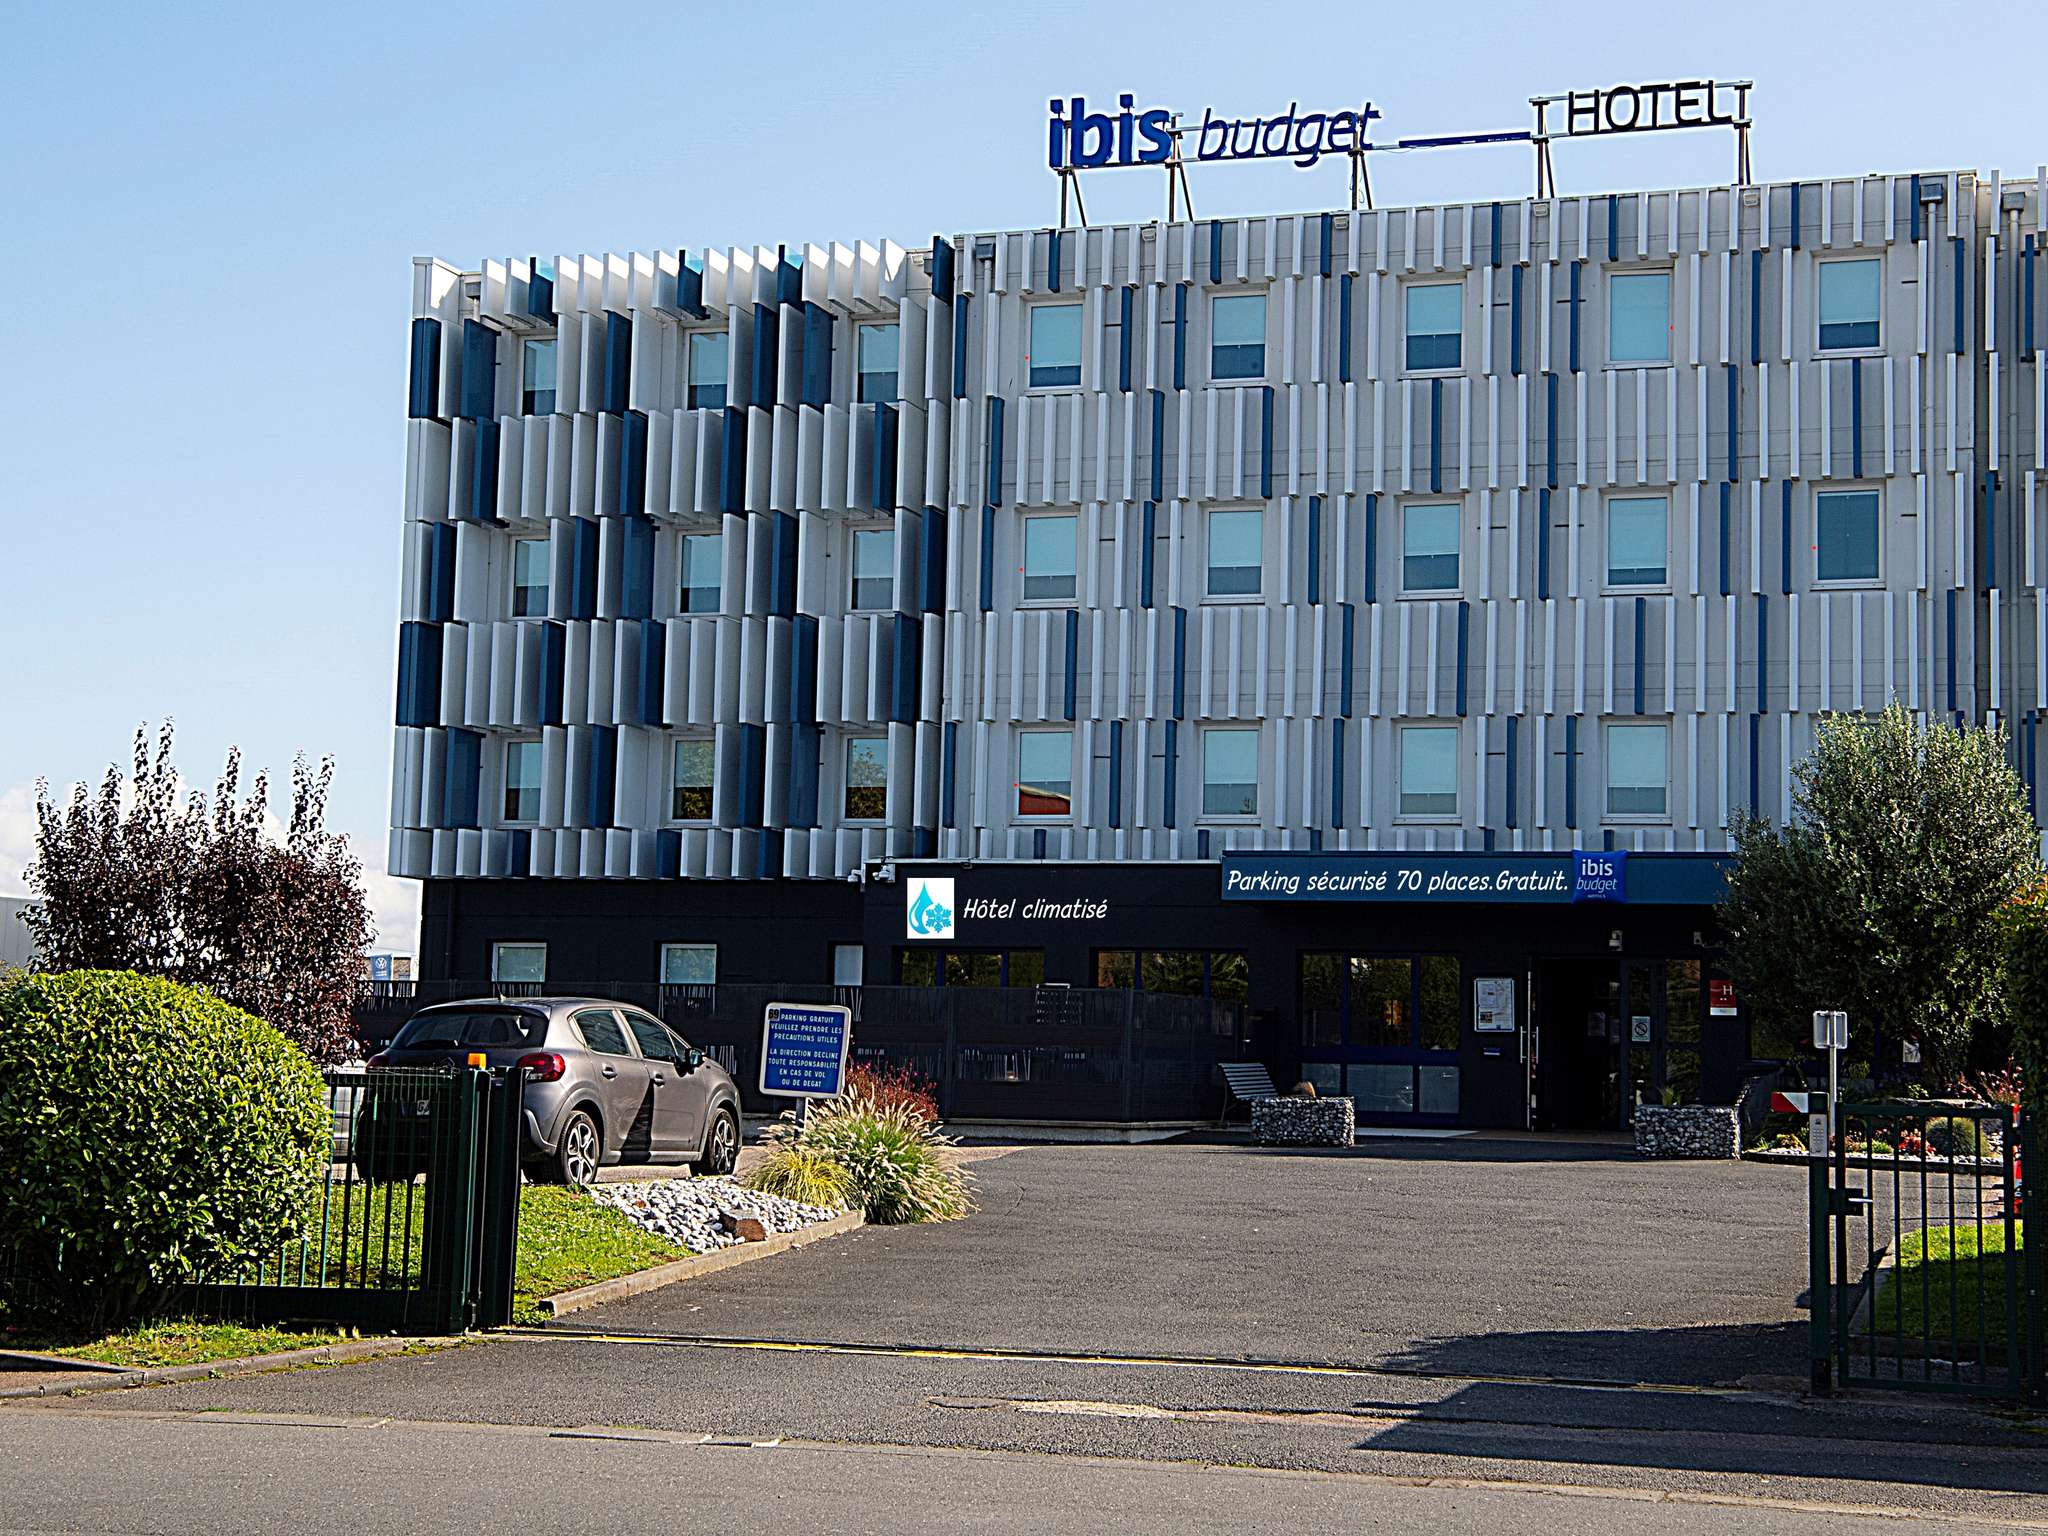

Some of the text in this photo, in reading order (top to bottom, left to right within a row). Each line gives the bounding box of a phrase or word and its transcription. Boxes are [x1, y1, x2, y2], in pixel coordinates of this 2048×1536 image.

[1567, 79, 1733, 136] HOTEL
[1049, 93, 1381, 168] ibis budget
[1581, 858, 1613, 876] ibis
[1227, 870, 1300, 895] Parking
[1306, 870, 1387, 891] sécurisé
[1396, 870, 1422, 891] 70
[1576, 877, 1618, 893] budget
[963, 898, 1108, 919] Hôtel climatisé
[781, 1013, 834, 1023] PARKING GRATUIT
[771, 1023, 842, 1034] VEUILLEZ PRENDRE LES
[780, 1049, 811, 1057] DIRECTION
[789, 1059, 838, 1069] RESPONSABILITE
[790, 1069, 802, 1077] CAS
